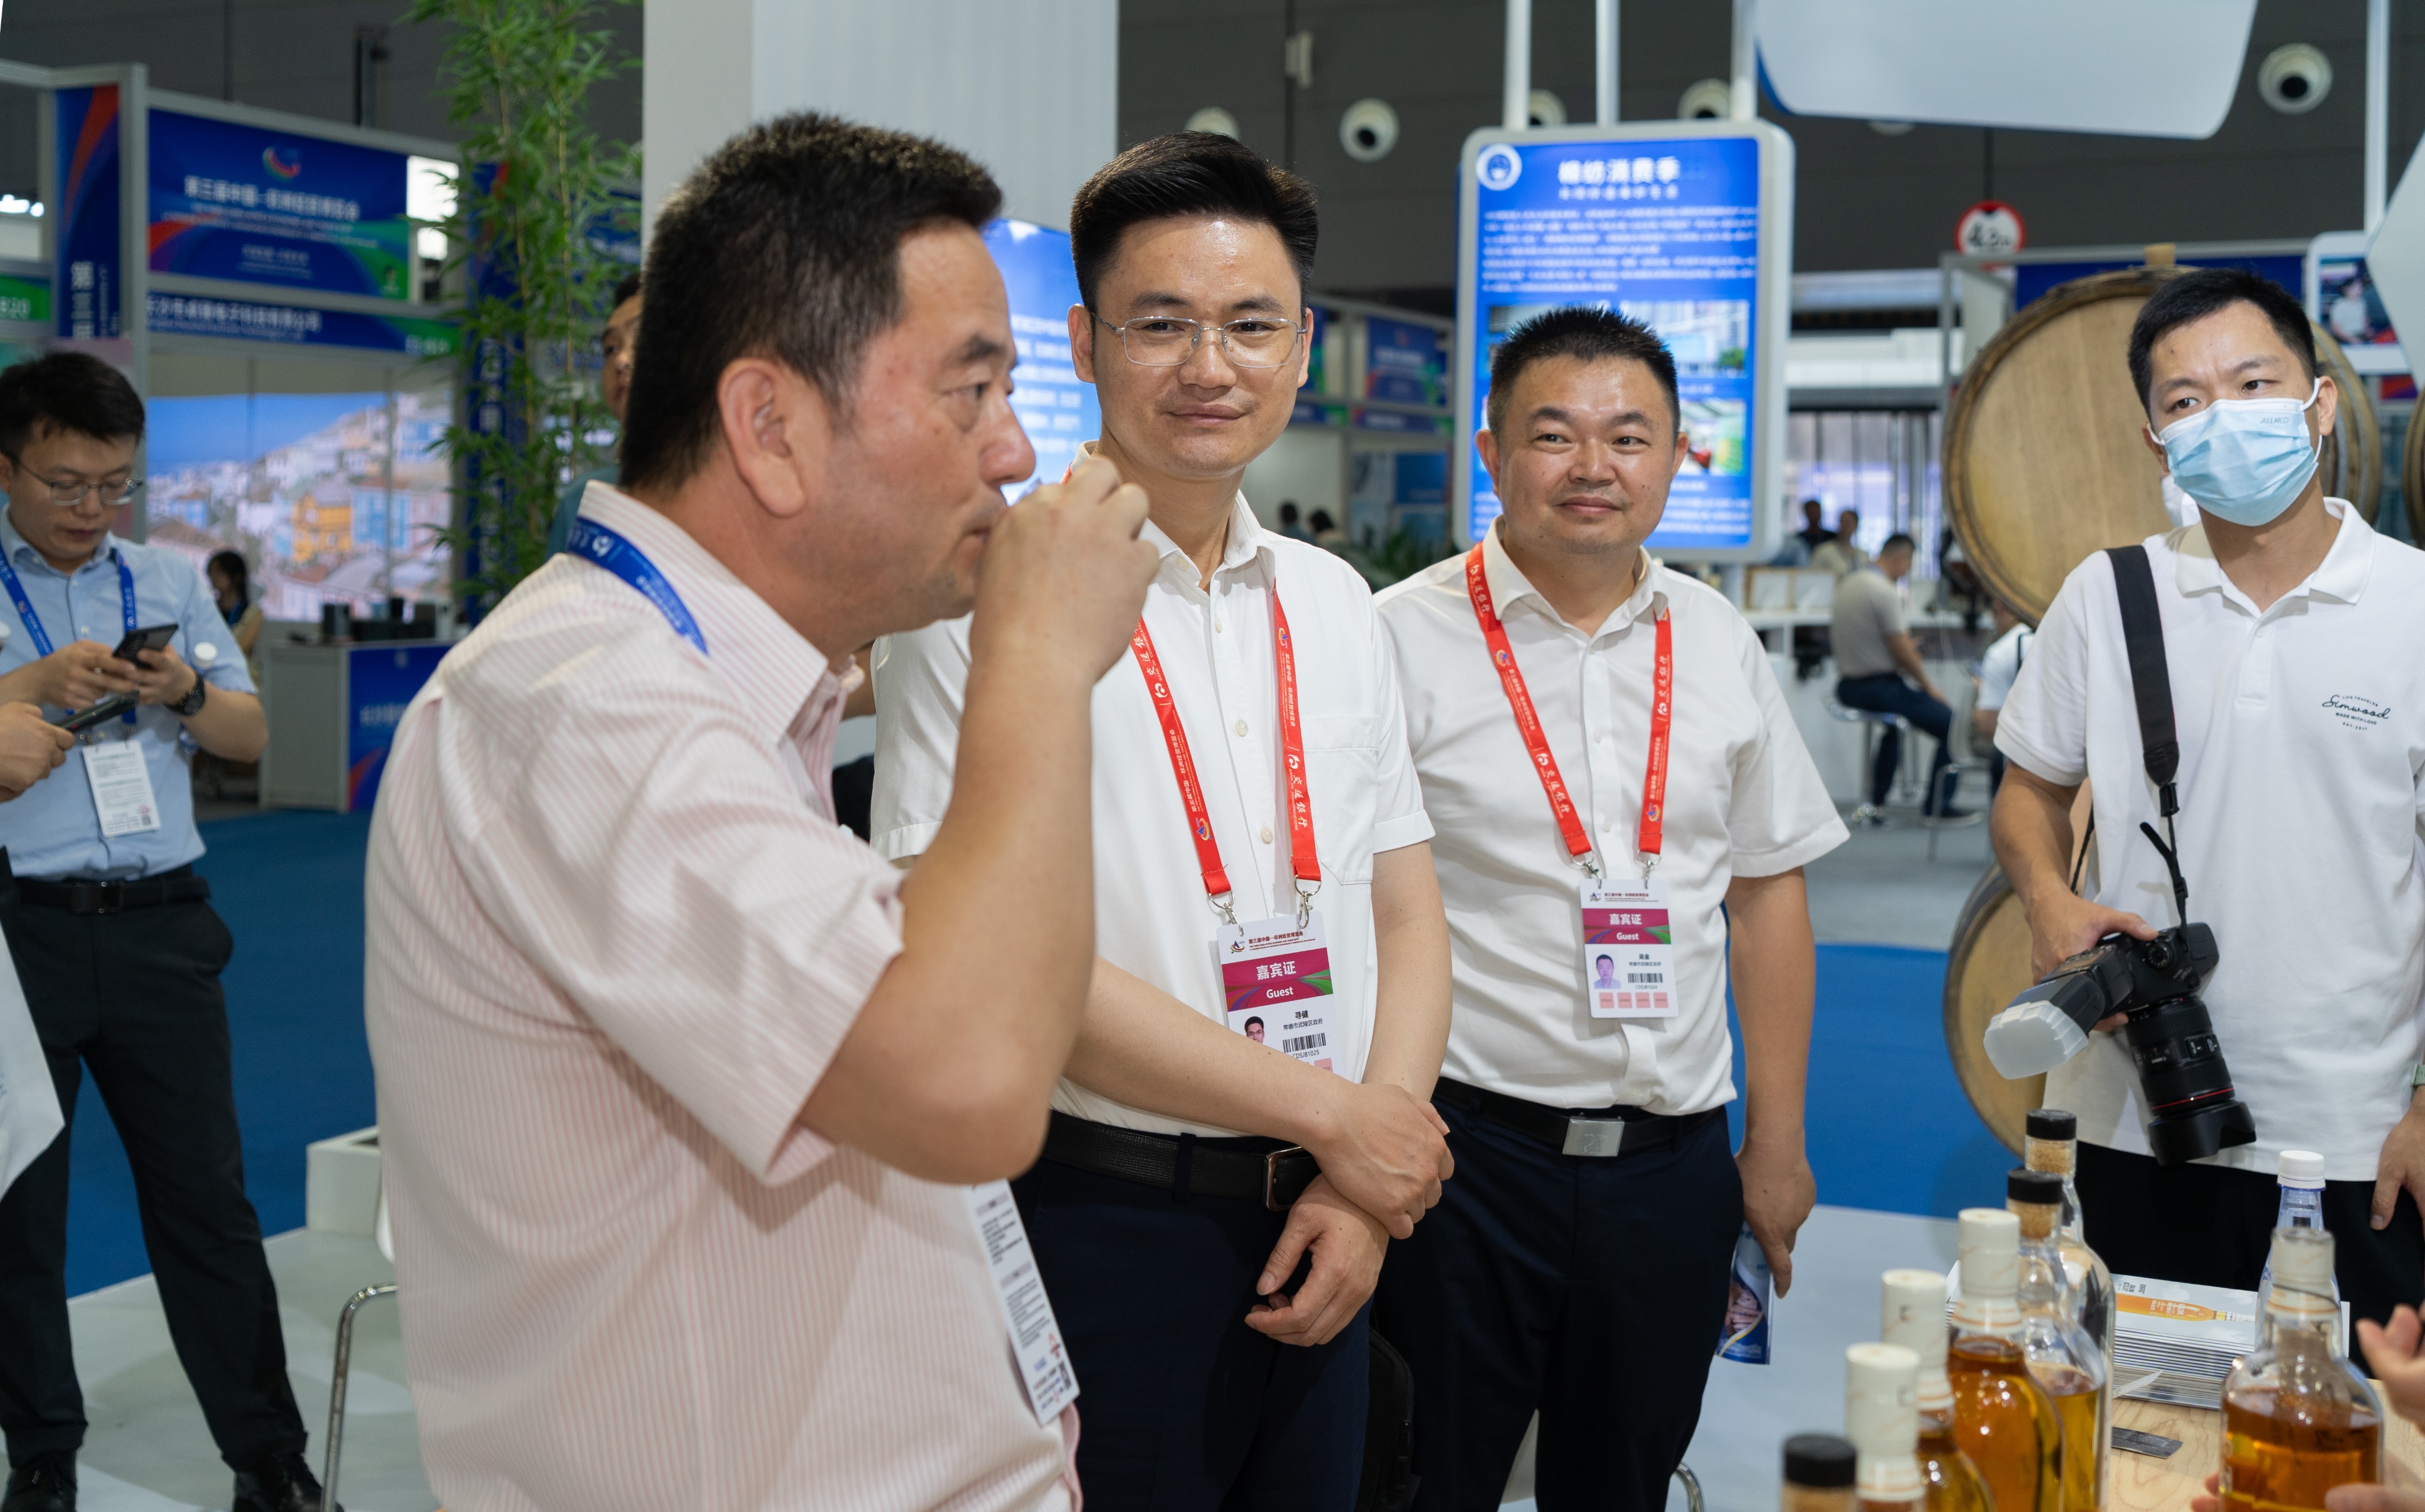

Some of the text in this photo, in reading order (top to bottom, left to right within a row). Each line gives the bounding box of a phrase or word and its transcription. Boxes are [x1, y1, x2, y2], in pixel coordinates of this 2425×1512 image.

[1609, 914, 1642, 925] 嘉宾证
[1616, 932, 1639, 940] Guest
[1256, 960, 1296, 980] 嘉宾证
[1266, 986, 1294, 999] Guest
[1295, 1010, 1308, 1019] 寻健
[1283, 1018, 1323, 1031] 常德市武陵区政府
